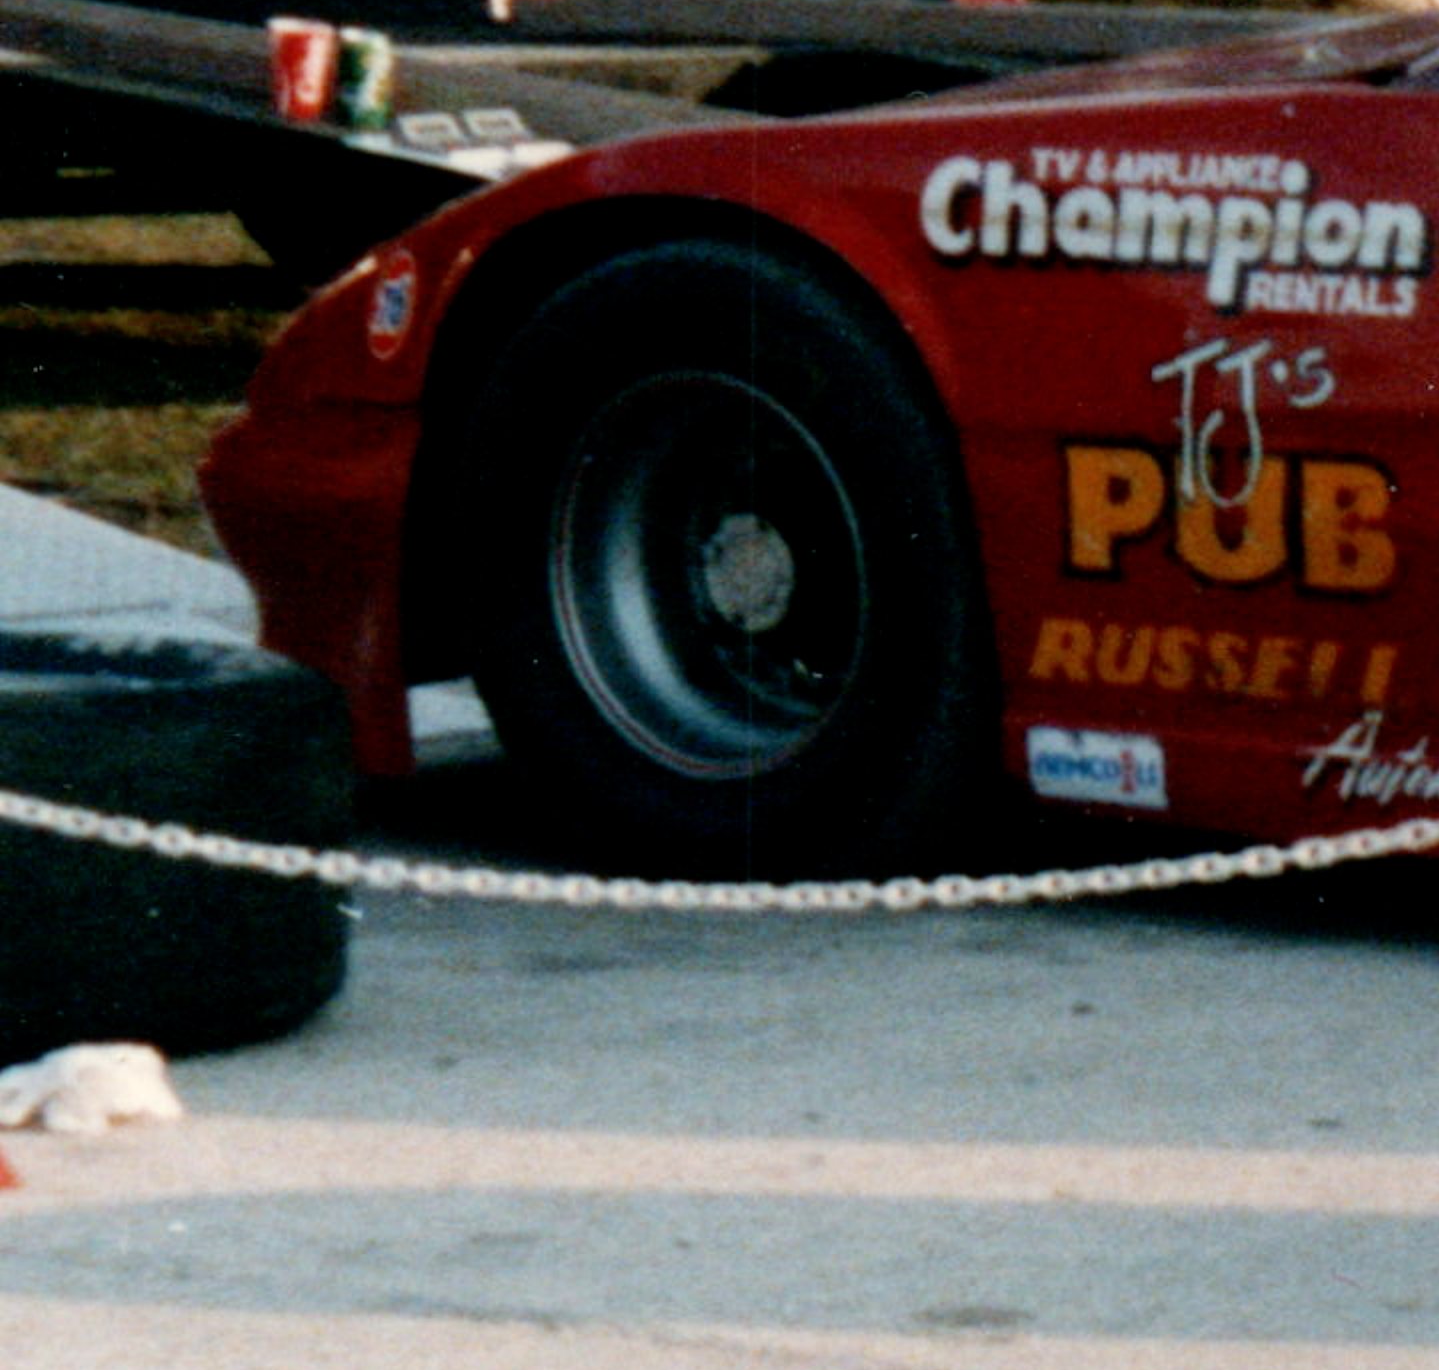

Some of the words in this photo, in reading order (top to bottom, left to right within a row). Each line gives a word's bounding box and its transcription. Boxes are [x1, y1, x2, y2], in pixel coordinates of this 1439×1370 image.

[1032, 148, 1080, 181] TV
[1113, 150, 1281, 192] APPLIANCE
[920, 157, 1426, 307] Champion
[1245, 272, 1418, 316] RENTALS
[1063, 444, 1396, 592] PUB
